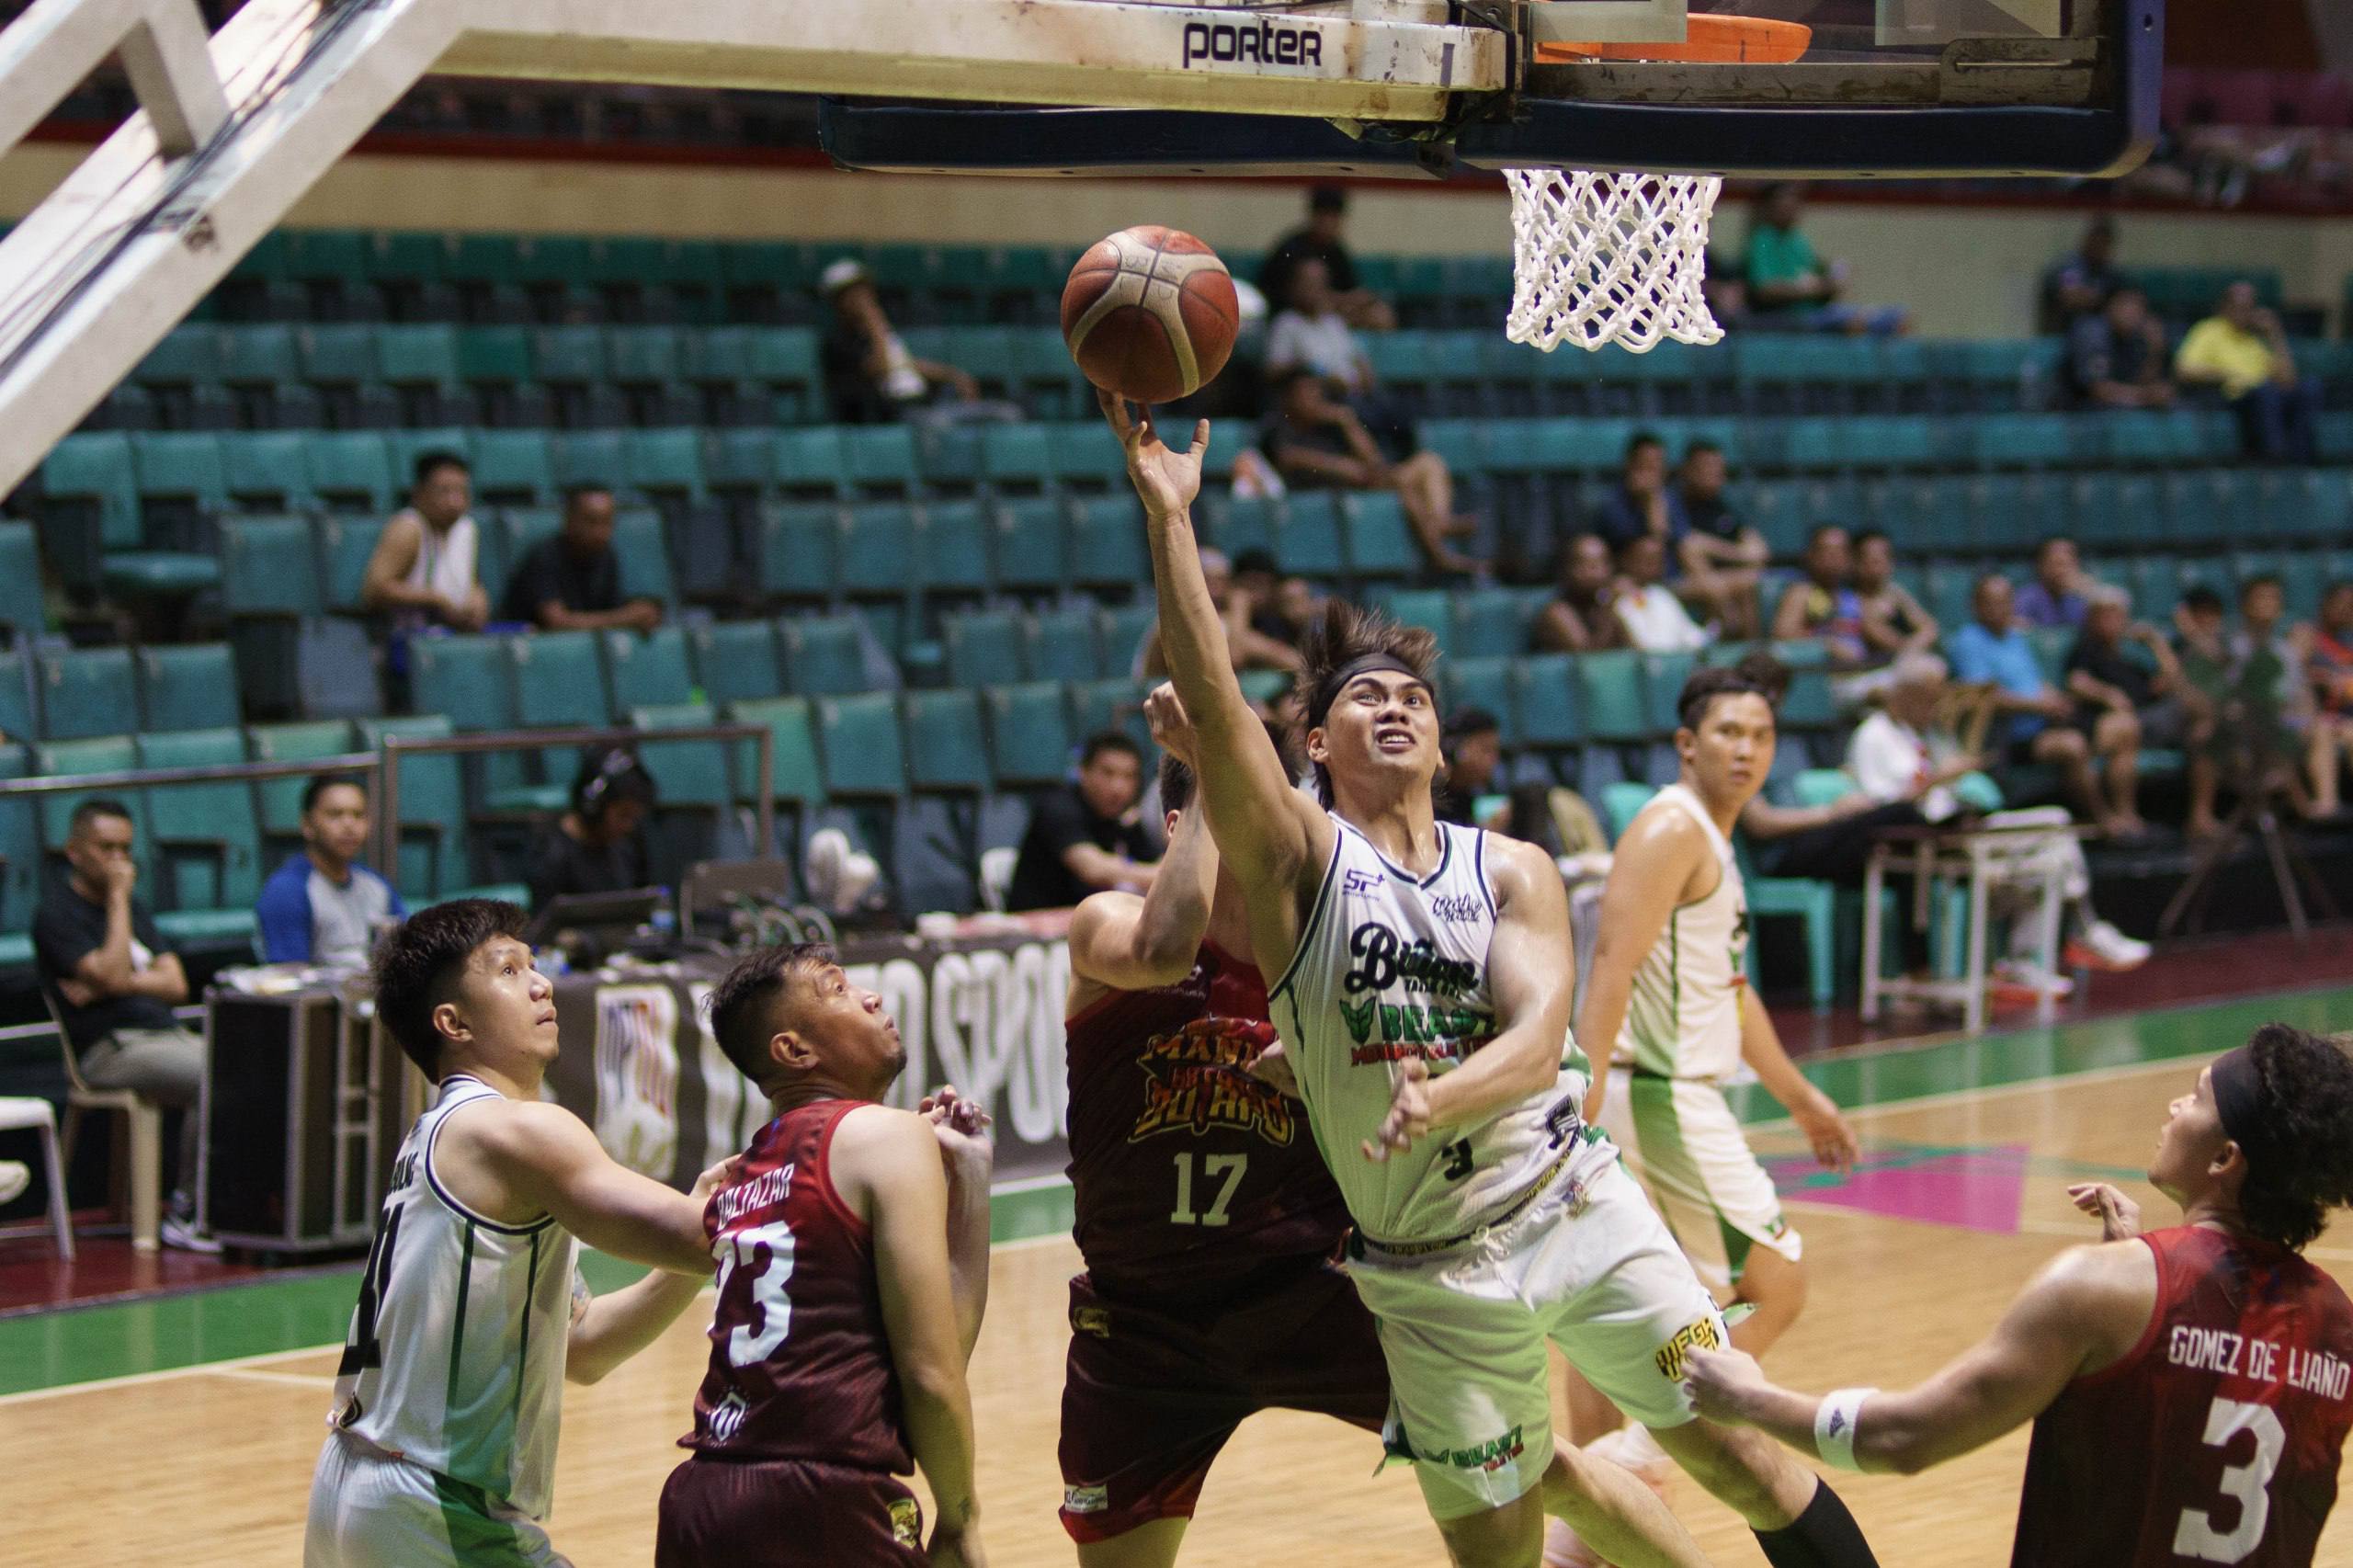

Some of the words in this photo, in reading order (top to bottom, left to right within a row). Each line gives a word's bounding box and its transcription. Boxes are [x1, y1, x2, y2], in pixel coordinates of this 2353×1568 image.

[716, 1163, 795, 1232] BALTAZAR
[1170, 1152, 1247, 1226] 17
[706, 1221, 797, 1368] 23
[2167, 1324, 2244, 1377] GOMEZ
[2246, 1338, 2281, 1383] DE
[2286, 1346, 2351, 1402] LIAÑO
[2172, 1396, 2287, 1565] 3
